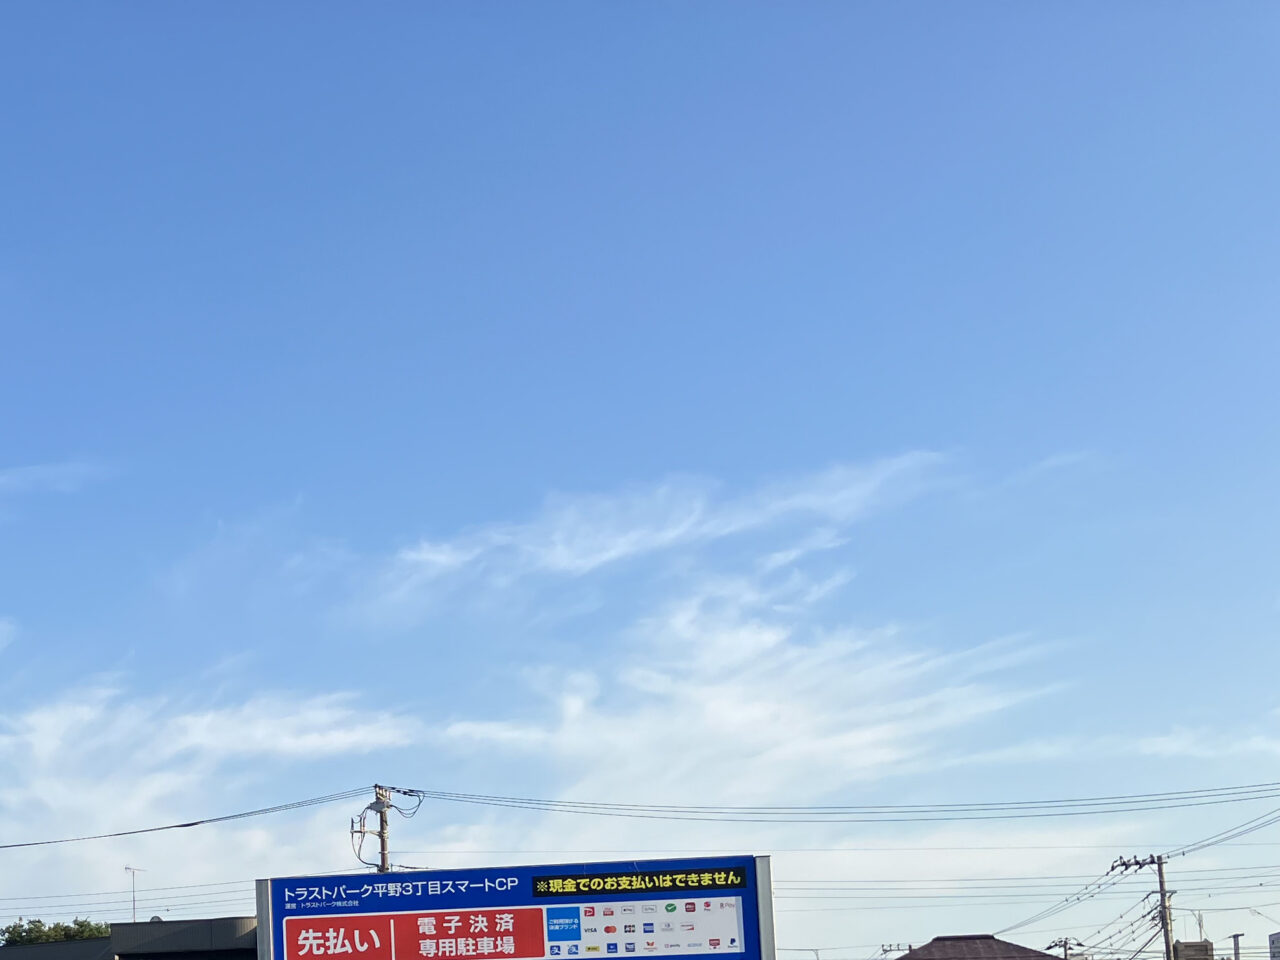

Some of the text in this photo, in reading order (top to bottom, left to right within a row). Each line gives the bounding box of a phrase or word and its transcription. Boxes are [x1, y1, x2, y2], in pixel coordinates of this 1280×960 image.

[284, 877, 519, 901] トラストパーク平野3丁目スマートCP
[536, 871, 741, 893] ※現金でのお支払いはできません
[417, 913, 514, 935] 電子決済
[297, 927, 381, 955] 先払い
[418, 936, 515, 958] 専用駐車場
